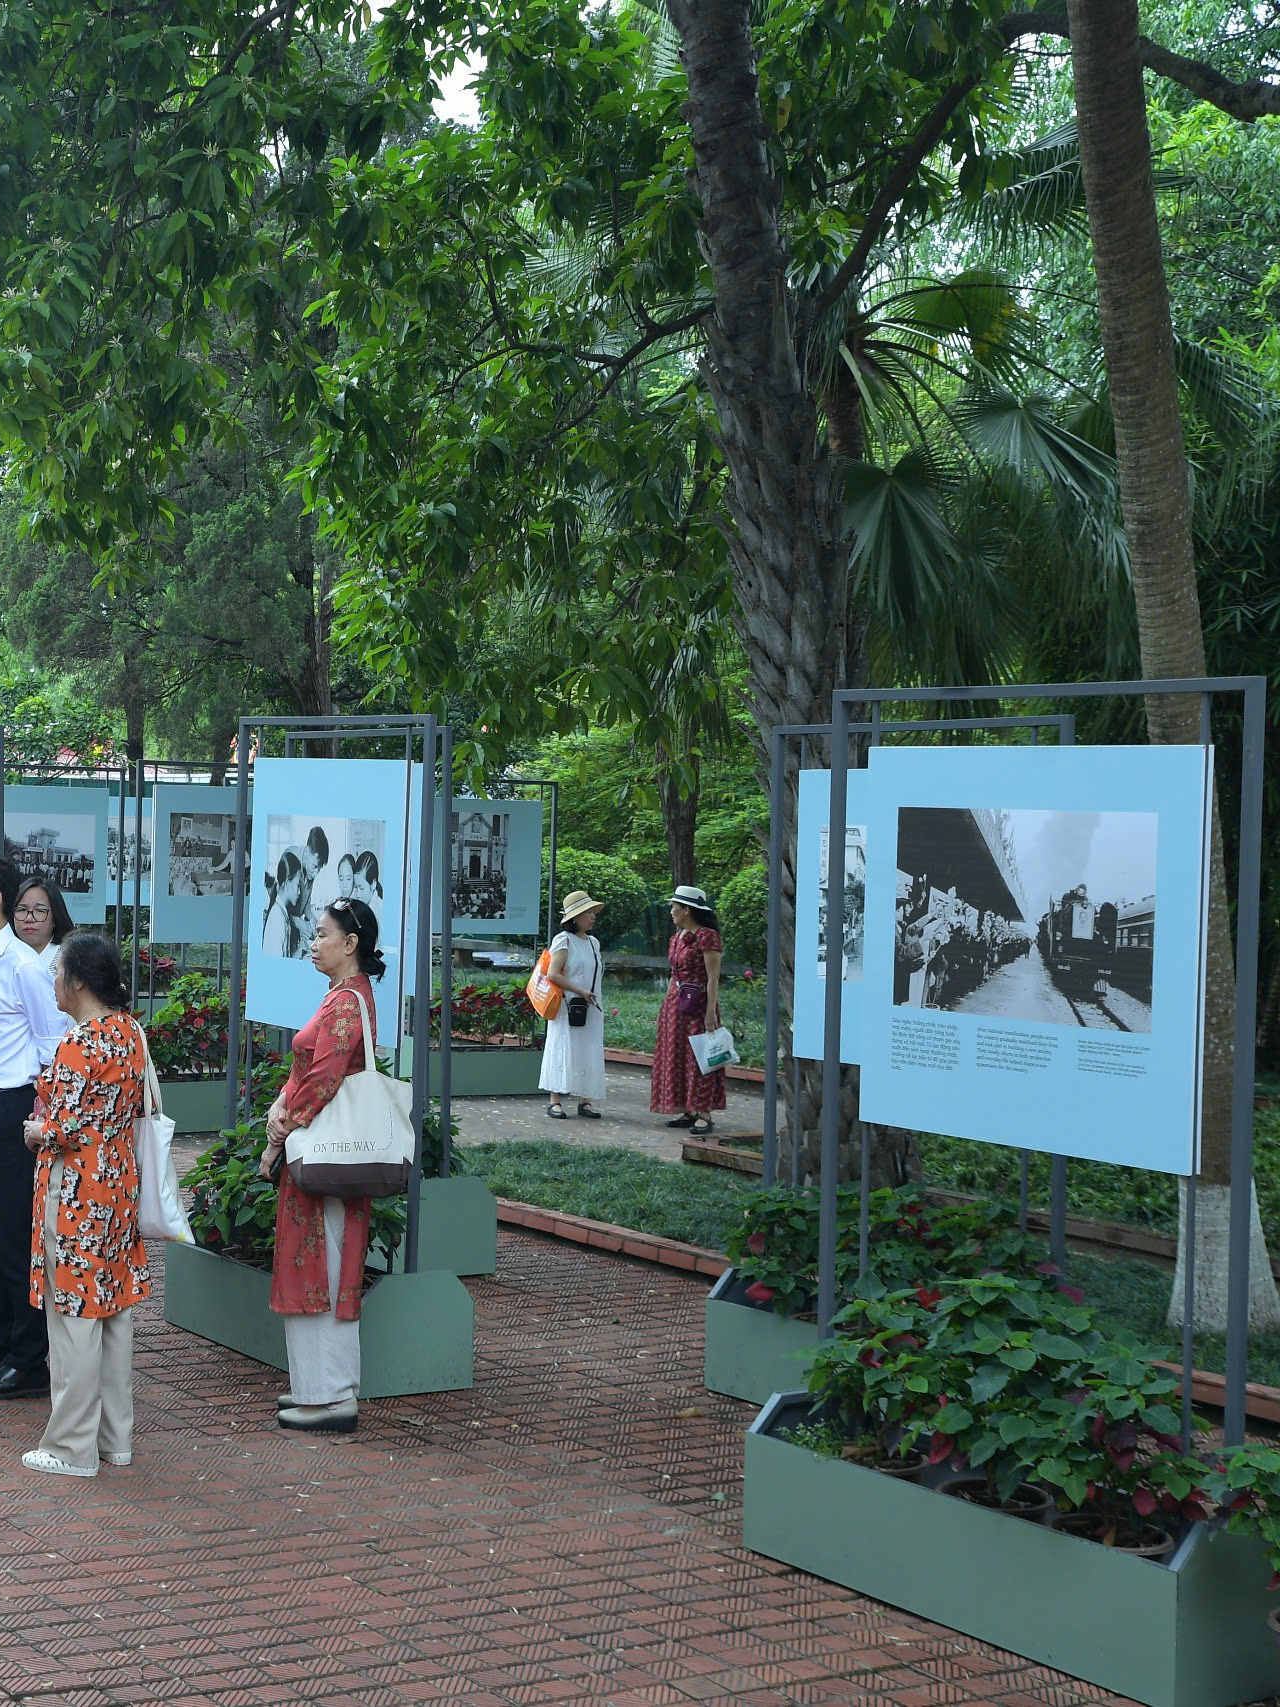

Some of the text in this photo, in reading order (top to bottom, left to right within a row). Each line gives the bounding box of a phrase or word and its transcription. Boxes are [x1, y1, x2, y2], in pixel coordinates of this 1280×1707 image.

[313, 1140, 376, 1152] ON THE WAY
